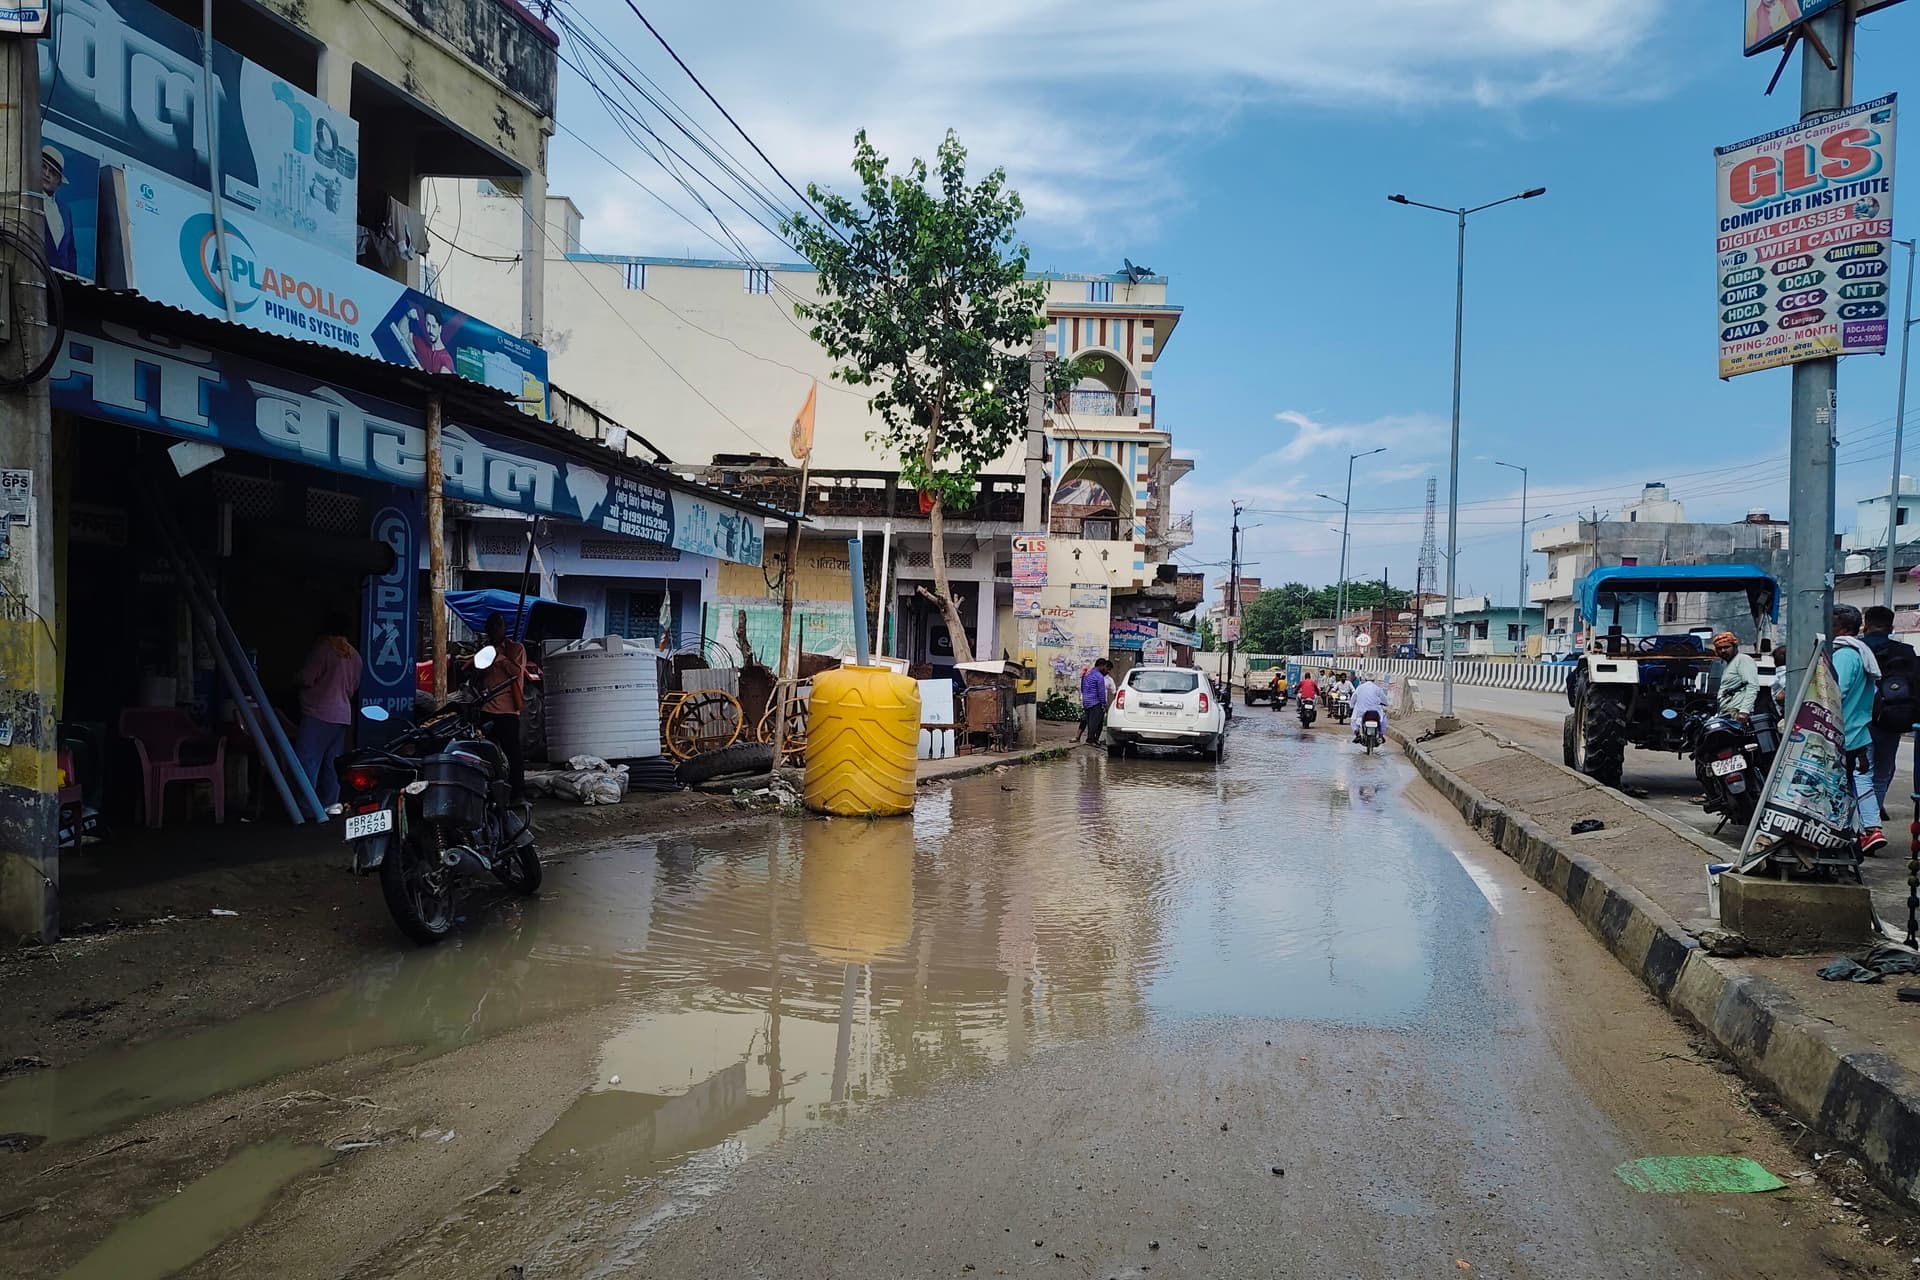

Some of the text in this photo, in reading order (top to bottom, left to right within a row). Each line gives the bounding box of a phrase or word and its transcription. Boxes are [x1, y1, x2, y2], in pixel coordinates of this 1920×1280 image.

[1722, 97, 1888, 153] ISO:9001:2015 CERTIFIED ORGANISATION
[1757, 121, 1850, 154] Fully AC Campus
[1729, 127, 1875, 205] GLS
[1720, 177, 1889, 233] COMPUTER INSTITUTE
[1719, 206, 1846, 251] DIGITAL CLASSES
[1760, 221, 1891, 259] WIFI CAMPUS
[1829, 243, 1878, 261] TALLY PRIME
[1777, 257, 1808, 273] DCA
[1845, 262, 1882, 277] DDTP
[1727, 269, 1760, 286] ADCA
[1785, 271, 1819, 290] DCAT
[261, 266, 359, 326] APOLLO
[1727, 286, 1759, 304] DMR
[1846, 284, 1880, 297] NTT
[1782, 291, 1820, 309] CCC
[1728, 304, 1760, 321] HDCA
[1843, 304, 1879, 317] C++
[264, 300, 360, 349] PIPING SYSTEMS
[1782, 314, 1820, 327] C Language
[1721, 324, 1838, 356] TYPING-200/- MONTH
[1726, 323, 1761, 340] JAVA
[2, 478, 28, 488] GPS
[1012, 535, 1047, 553] GLS
[376, 517, 406, 667] GUPTA
[387, 697, 415, 712] PIPE
[354, 821, 386, 837] P7529
